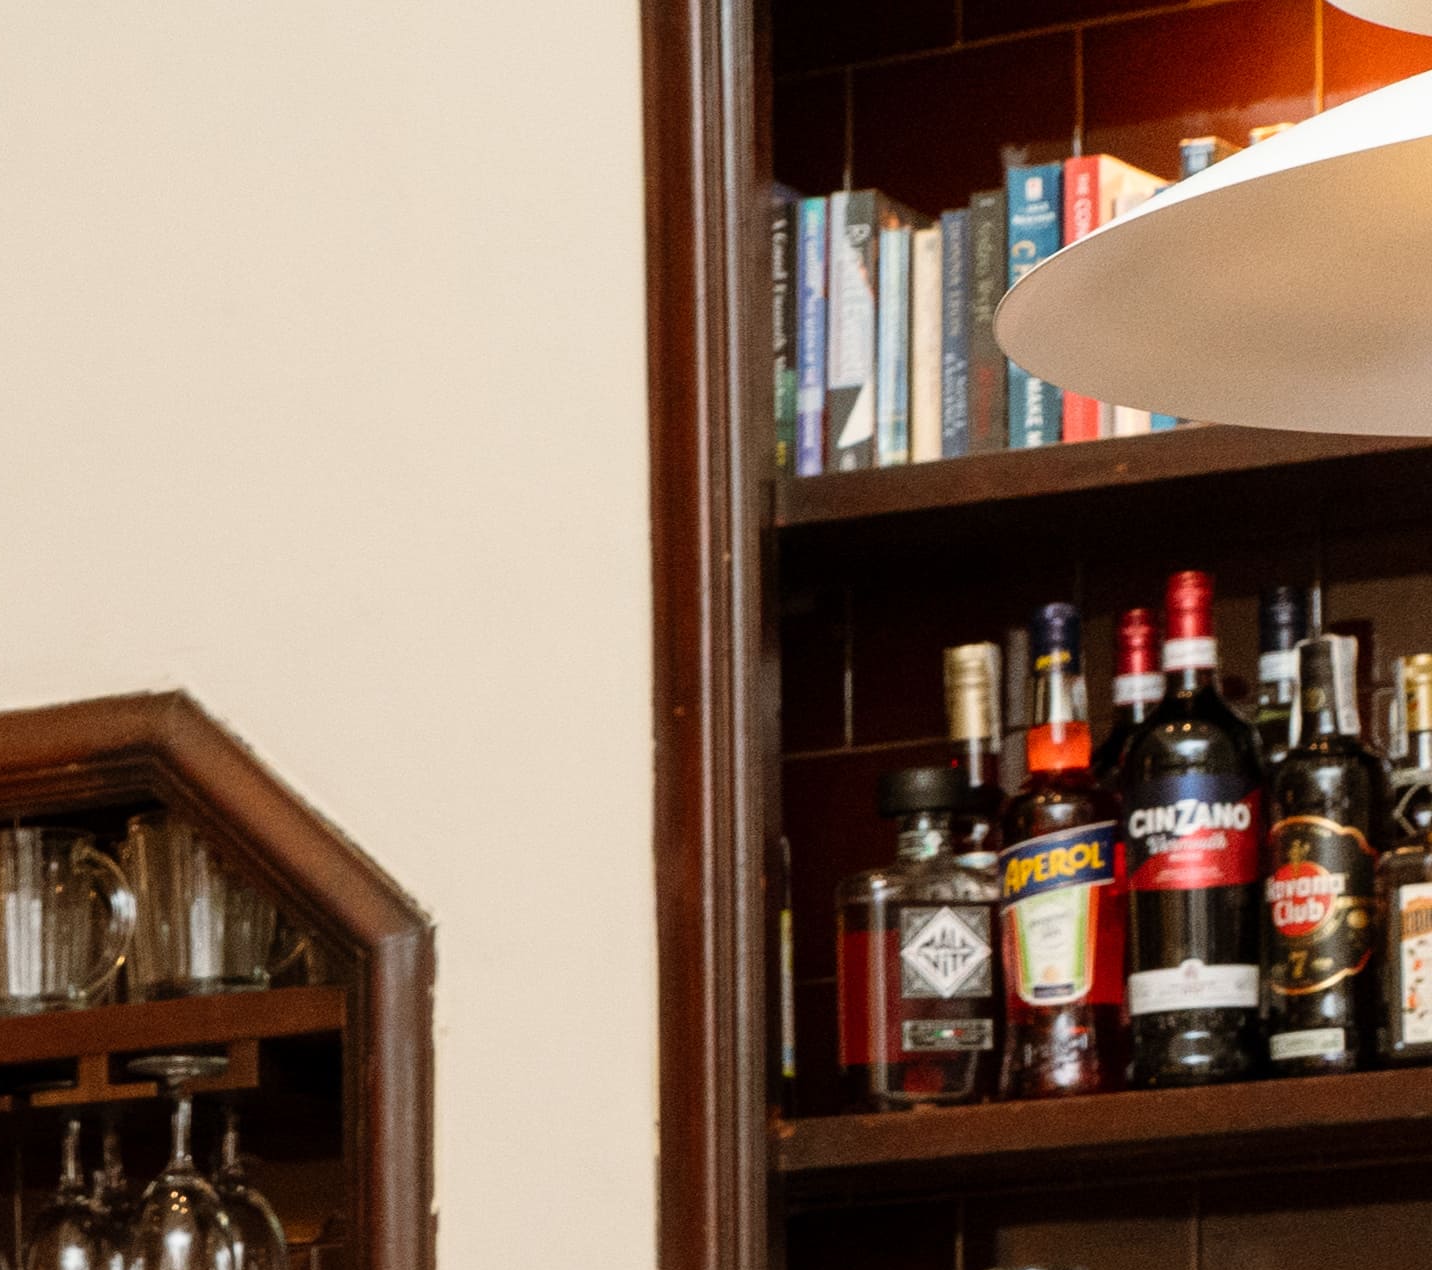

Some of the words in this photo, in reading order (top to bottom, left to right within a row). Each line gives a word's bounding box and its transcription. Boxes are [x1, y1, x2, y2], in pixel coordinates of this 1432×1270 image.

[1128, 798, 1252, 839] CINZANO
[1004, 840, 1106, 898] APEROL
[1265, 872, 1347, 903] Havana
[1273, 896, 1325, 926] Club
